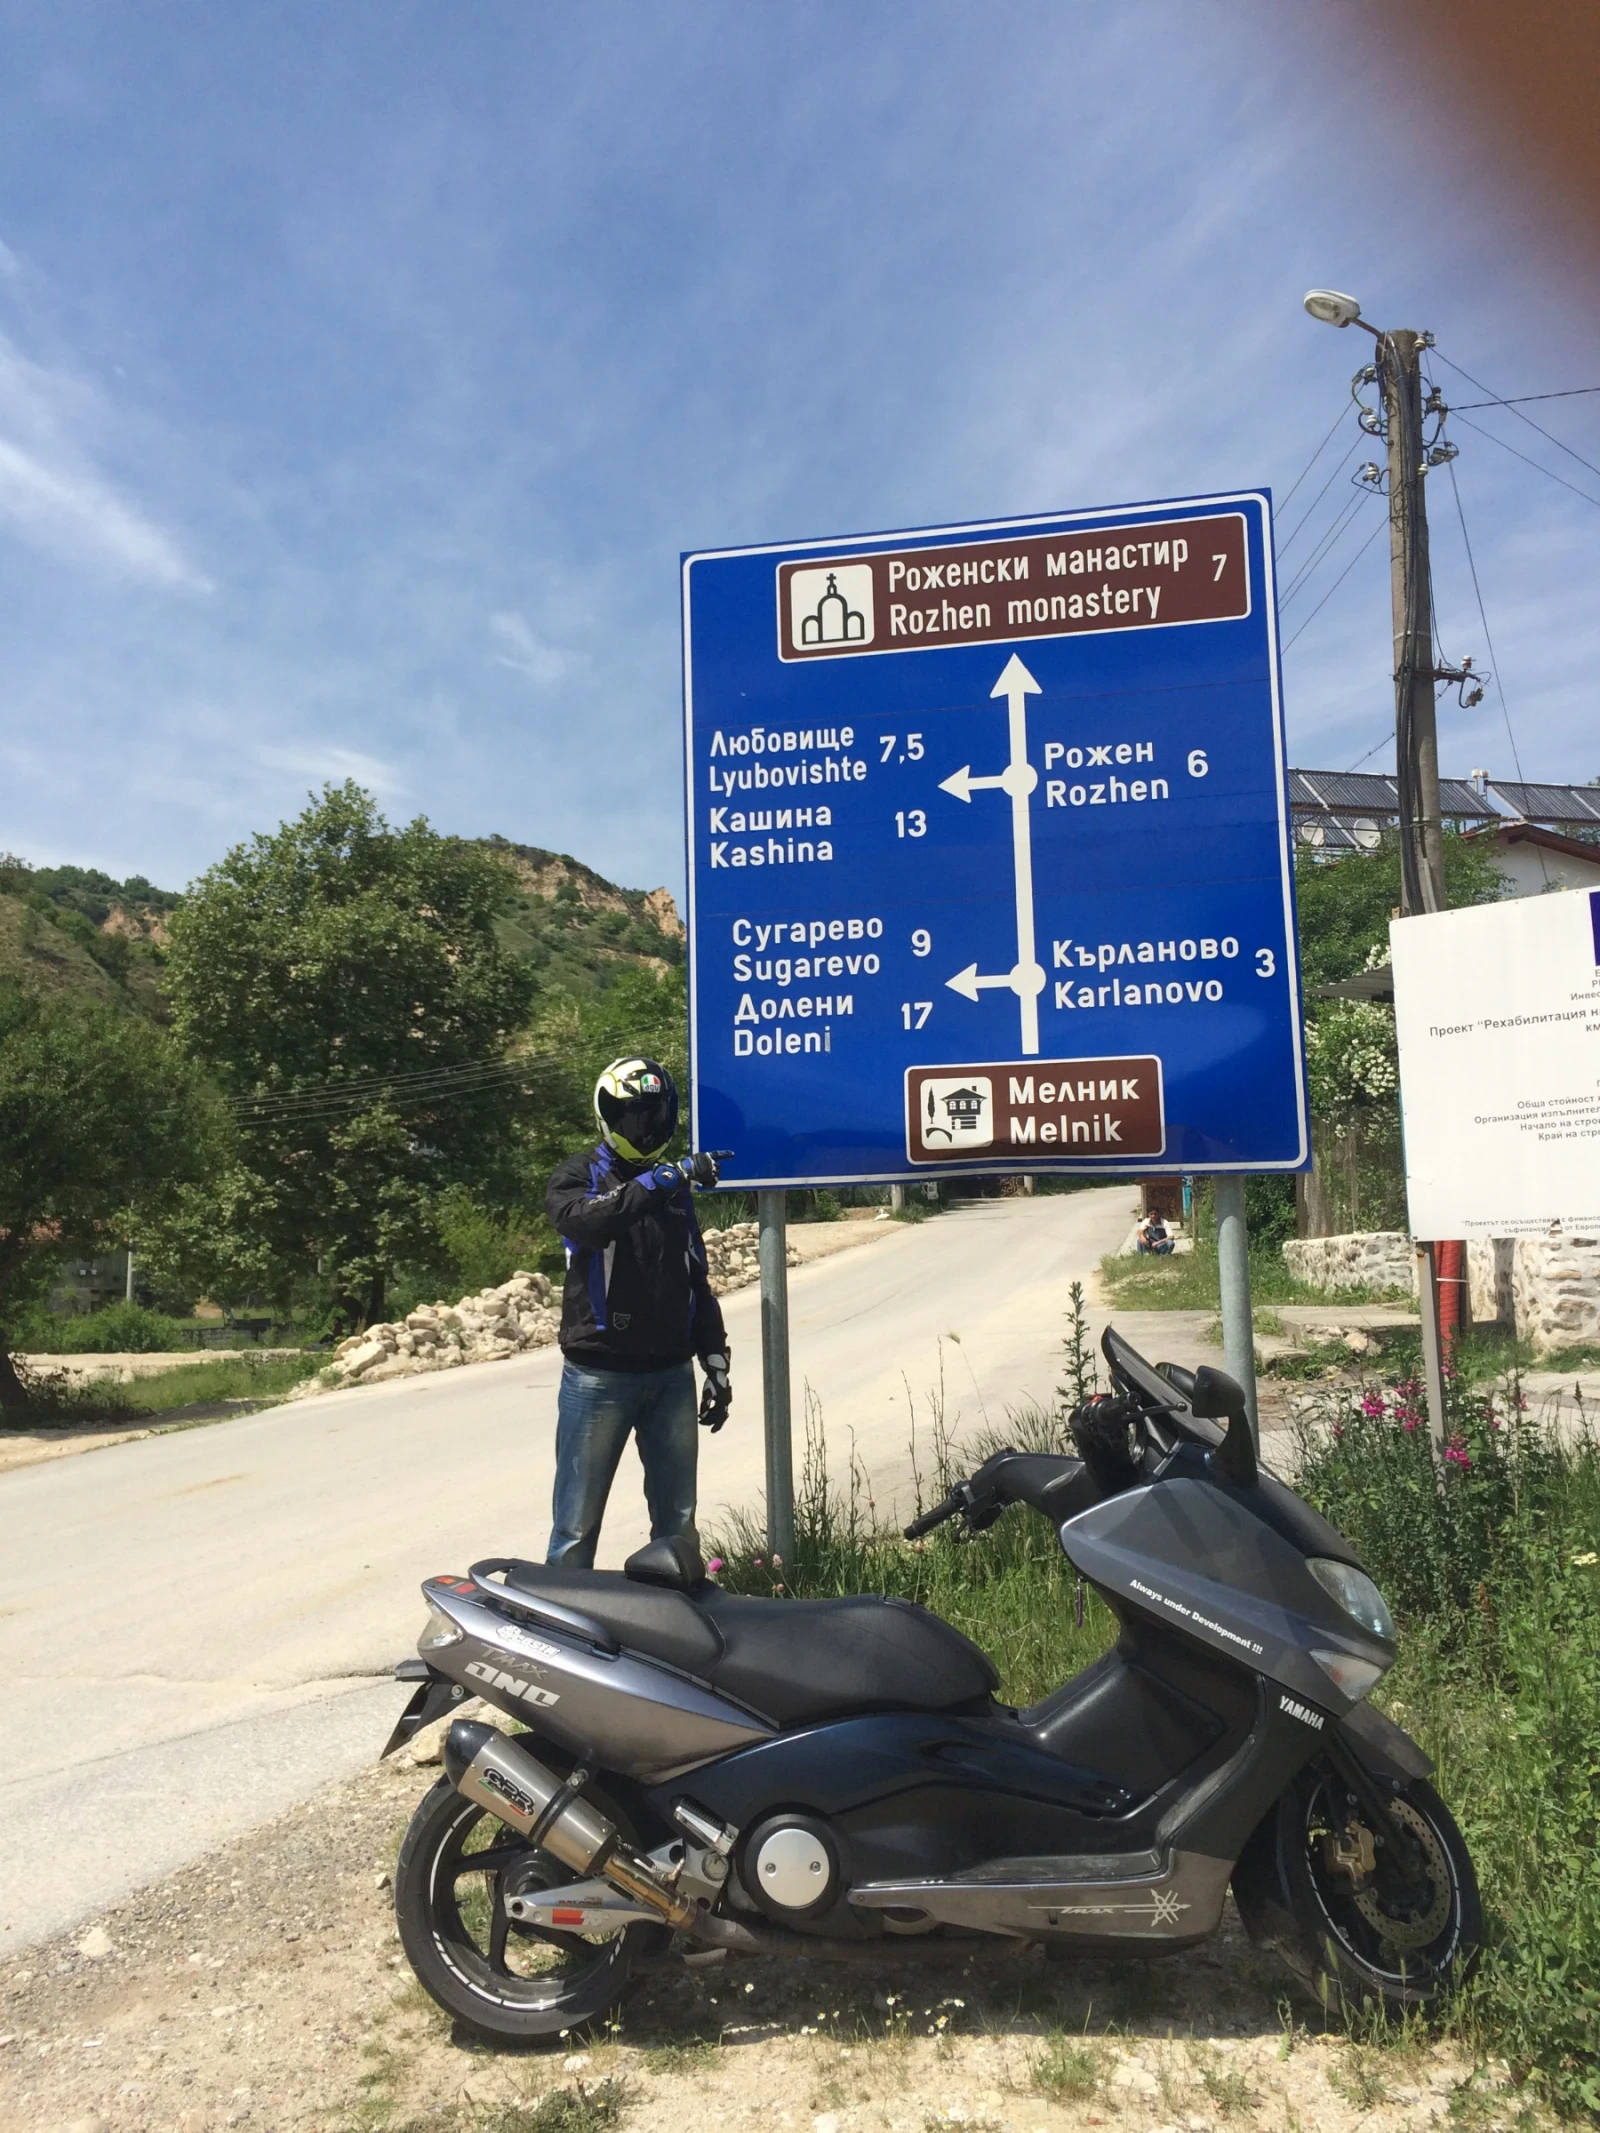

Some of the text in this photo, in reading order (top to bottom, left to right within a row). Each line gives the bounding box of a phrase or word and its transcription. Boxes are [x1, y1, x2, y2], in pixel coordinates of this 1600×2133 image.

[887, 538, 1228, 593] Роженски манастир 7
[890, 584, 1163, 637] Rozhen monastery
[710, 726, 925, 765] Любовище 7,5
[1044, 742, 1209, 778] Рожен 6
[709, 755, 867, 797] Lyubovishte
[1046, 773, 1169, 808] Rozhen
[710, 805, 927, 838] Кашина 13
[710, 838, 833, 869] Kashina
[732, 917, 931, 957] Сугарево 9
[733, 952, 880, 987] Sugarevo
[1053, 937, 1276, 978] Кърланово 3
[1055, 978, 1223, 1009] Karlanovo
[734, 993, 933, 1030] Долени 17
[734, 1025, 831, 1057] Doleni
[1429, 1023, 1474, 1038] Проект
[1008, 1075, 1140, 1105] Мелник
[1517, 1100, 1546, 1110] Обща
[1548, 1095, 1595, 1107] стойност
[1009, 1112, 1123, 1144] Melnik
[1474, 1111, 1539, 1125] Организация
[1520, 1118, 1600, 1131] Начало на стро
[1538, 1131, 1563, 1142] Край
[1565, 1131, 1578, 1139] на
[1129, 1579, 1263, 1655] Always under Development !!!
[1280, 1695, 1324, 1730] YAMAHA
